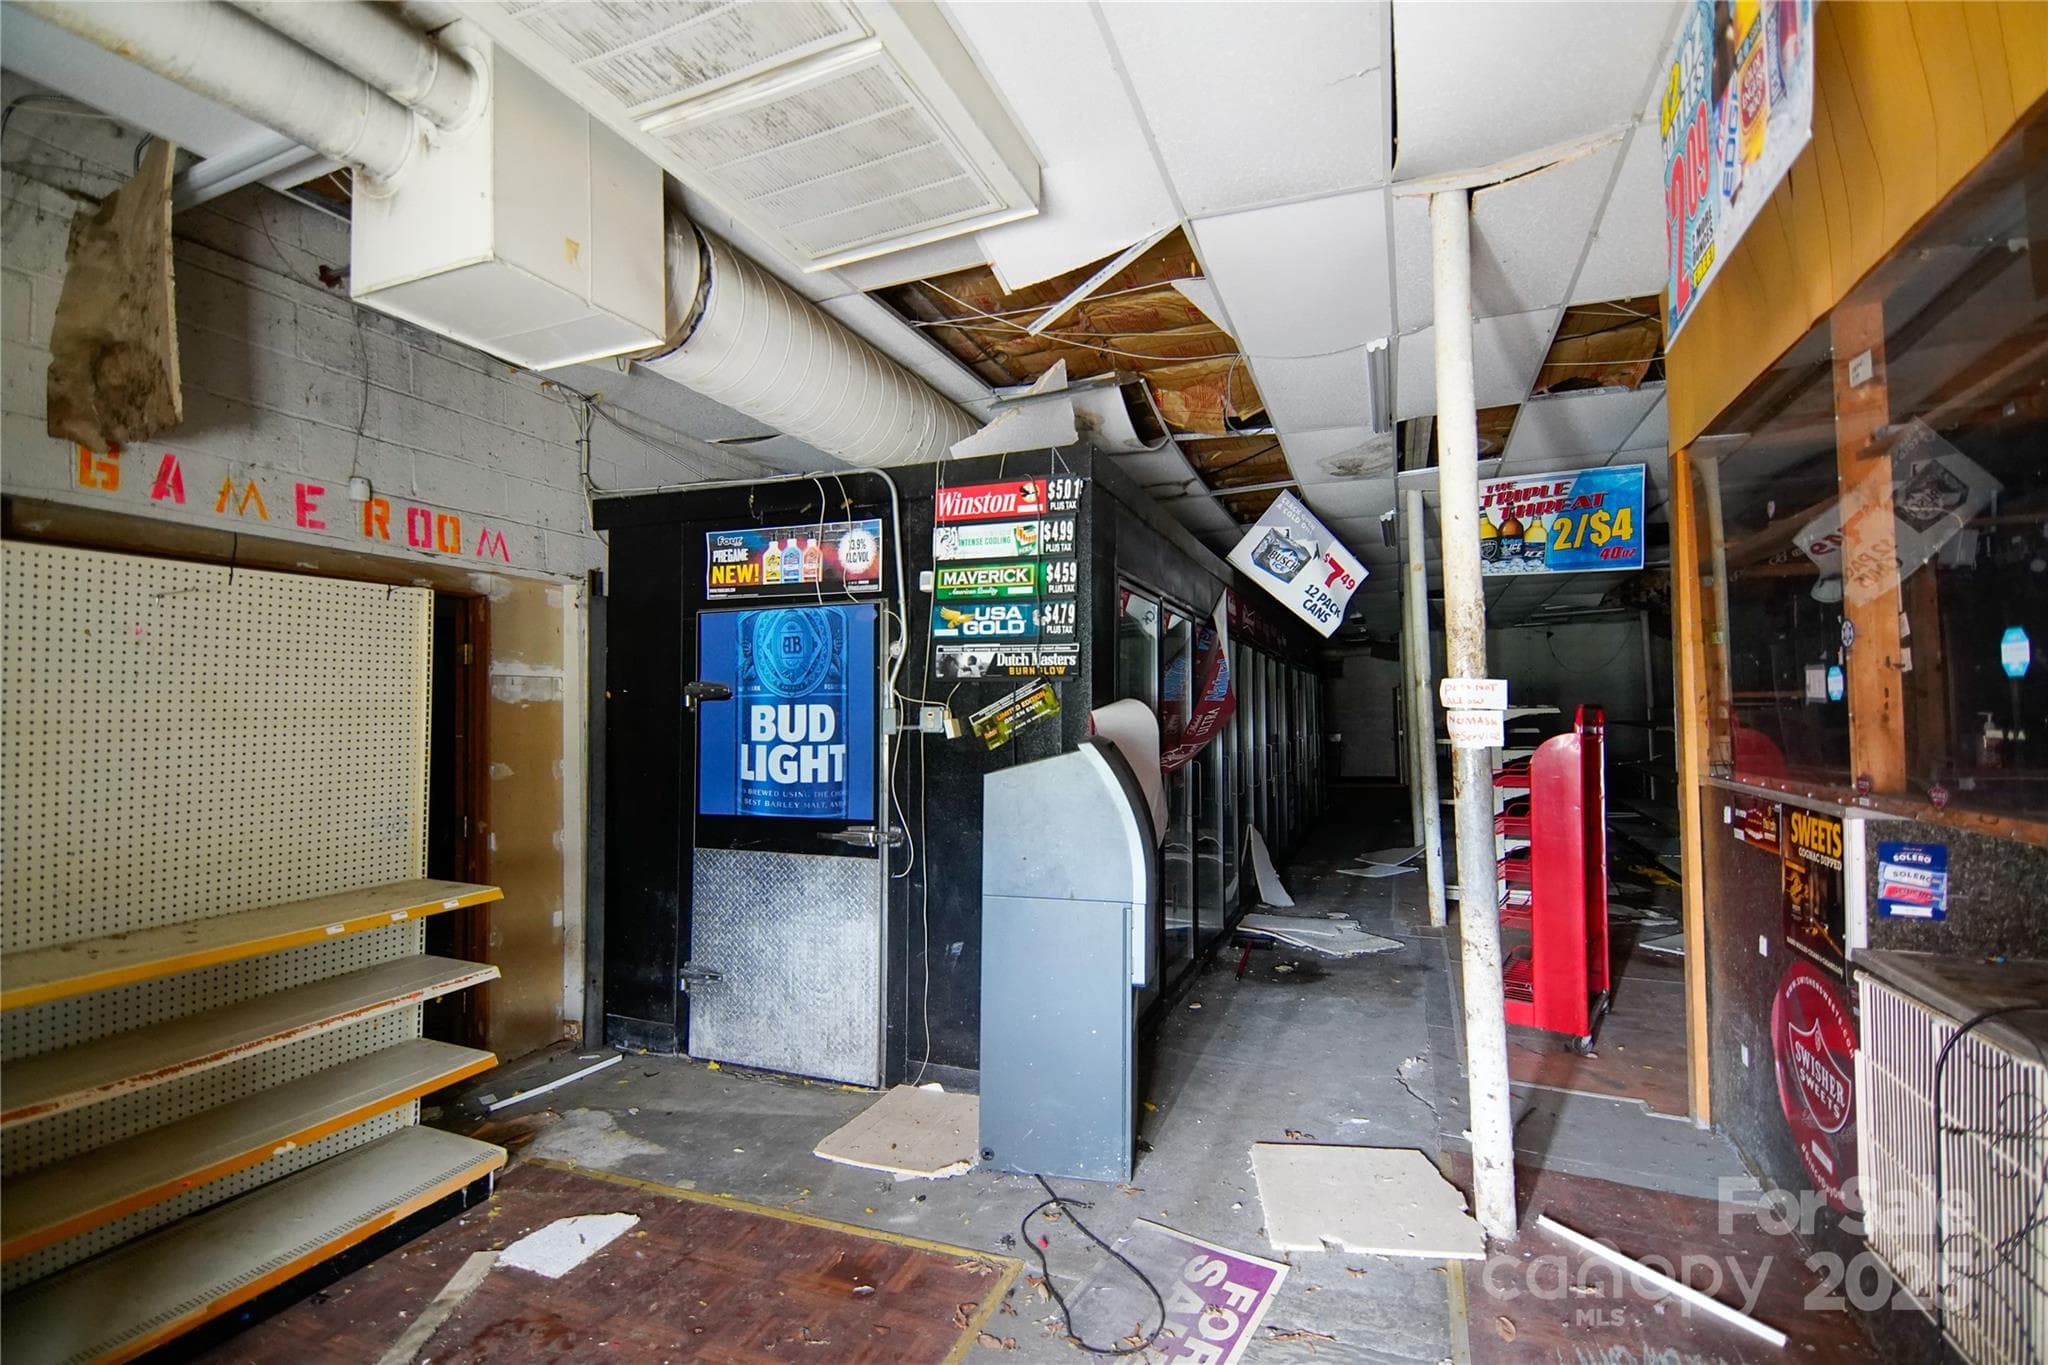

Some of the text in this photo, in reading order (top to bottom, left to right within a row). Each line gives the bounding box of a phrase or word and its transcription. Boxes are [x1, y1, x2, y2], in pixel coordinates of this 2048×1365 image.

[1481, 481, 1573, 508] TRIPLE
[1486, 481, 1518, 493] THE
[79, 443, 510, 562] GAME ROOM
[938, 491, 1017, 517] Winston
[1050, 500, 1077, 511] PLUS TAX
[1499, 492, 1609, 520] THREAT
[1282, 508, 1300, 523] COLD
[1553, 508, 1634, 550] 2/$4
[984, 535, 1011, 545] COOLING
[1046, 543, 1072, 552] PLUS TAX
[713, 549, 749, 562] PREGAME
[1268, 550, 1299, 572] BUSCH
[711, 563, 760, 584] NEW!
[1271, 561, 1285, 572] ICE
[943, 568, 1028, 586] MAVERICK
[1048, 584, 1075, 593] PLUS TAX
[1304, 584, 1342, 618] 12 PACK
[975, 606, 1022, 620] USA
[1302, 598, 1332, 624] CANS
[963, 620, 1025, 635] GOLD
[1047, 625, 1073, 634] PLUS TAX
[996, 652, 1030, 666] Dutch
[1009, 666, 1066, 675] BURN LOW
[996, 704, 1021, 721] LIMITD
[1004, 710, 1026, 724] GREN
[751, 704, 836, 742] BUD
[741, 743, 846, 784] LIGHT
[747, 788, 779, 797] BREWED
[764, 800, 800, 808] BARLEY
[1791, 811, 1842, 858] SWEETS
[1798, 846, 1842, 871] COGNAC DIPPED
[1893, 852, 1932, 864] SOLERO
[1892, 870, 1932, 883] SOLERO
[1794, 1040, 1845, 1108] SWISHER
[1800, 1067, 1840, 1119] SWEETS
[1172, 1281, 1259, 1365] FOR
